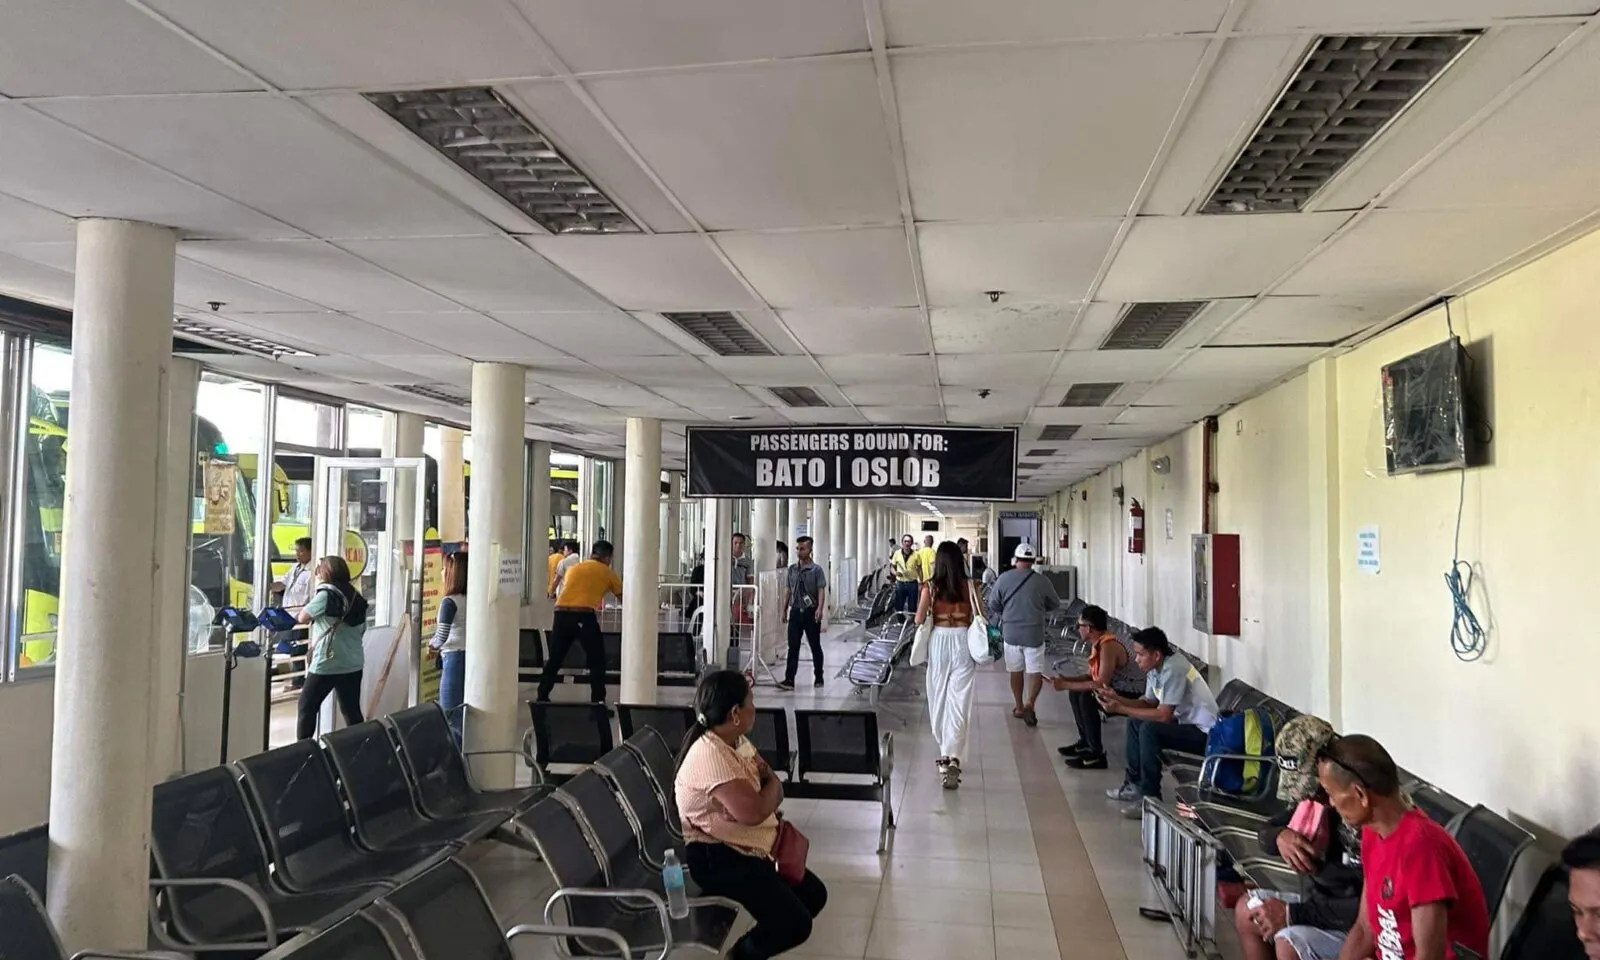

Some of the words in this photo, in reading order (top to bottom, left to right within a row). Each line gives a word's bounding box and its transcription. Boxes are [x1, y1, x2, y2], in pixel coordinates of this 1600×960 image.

[751, 433, 849, 451] PASSENGERS
[853, 433, 909, 451] BOUND
[913, 433, 948, 452] FOR:
[756, 457, 826, 487] BATO
[851, 457, 940, 487] OSLOB
